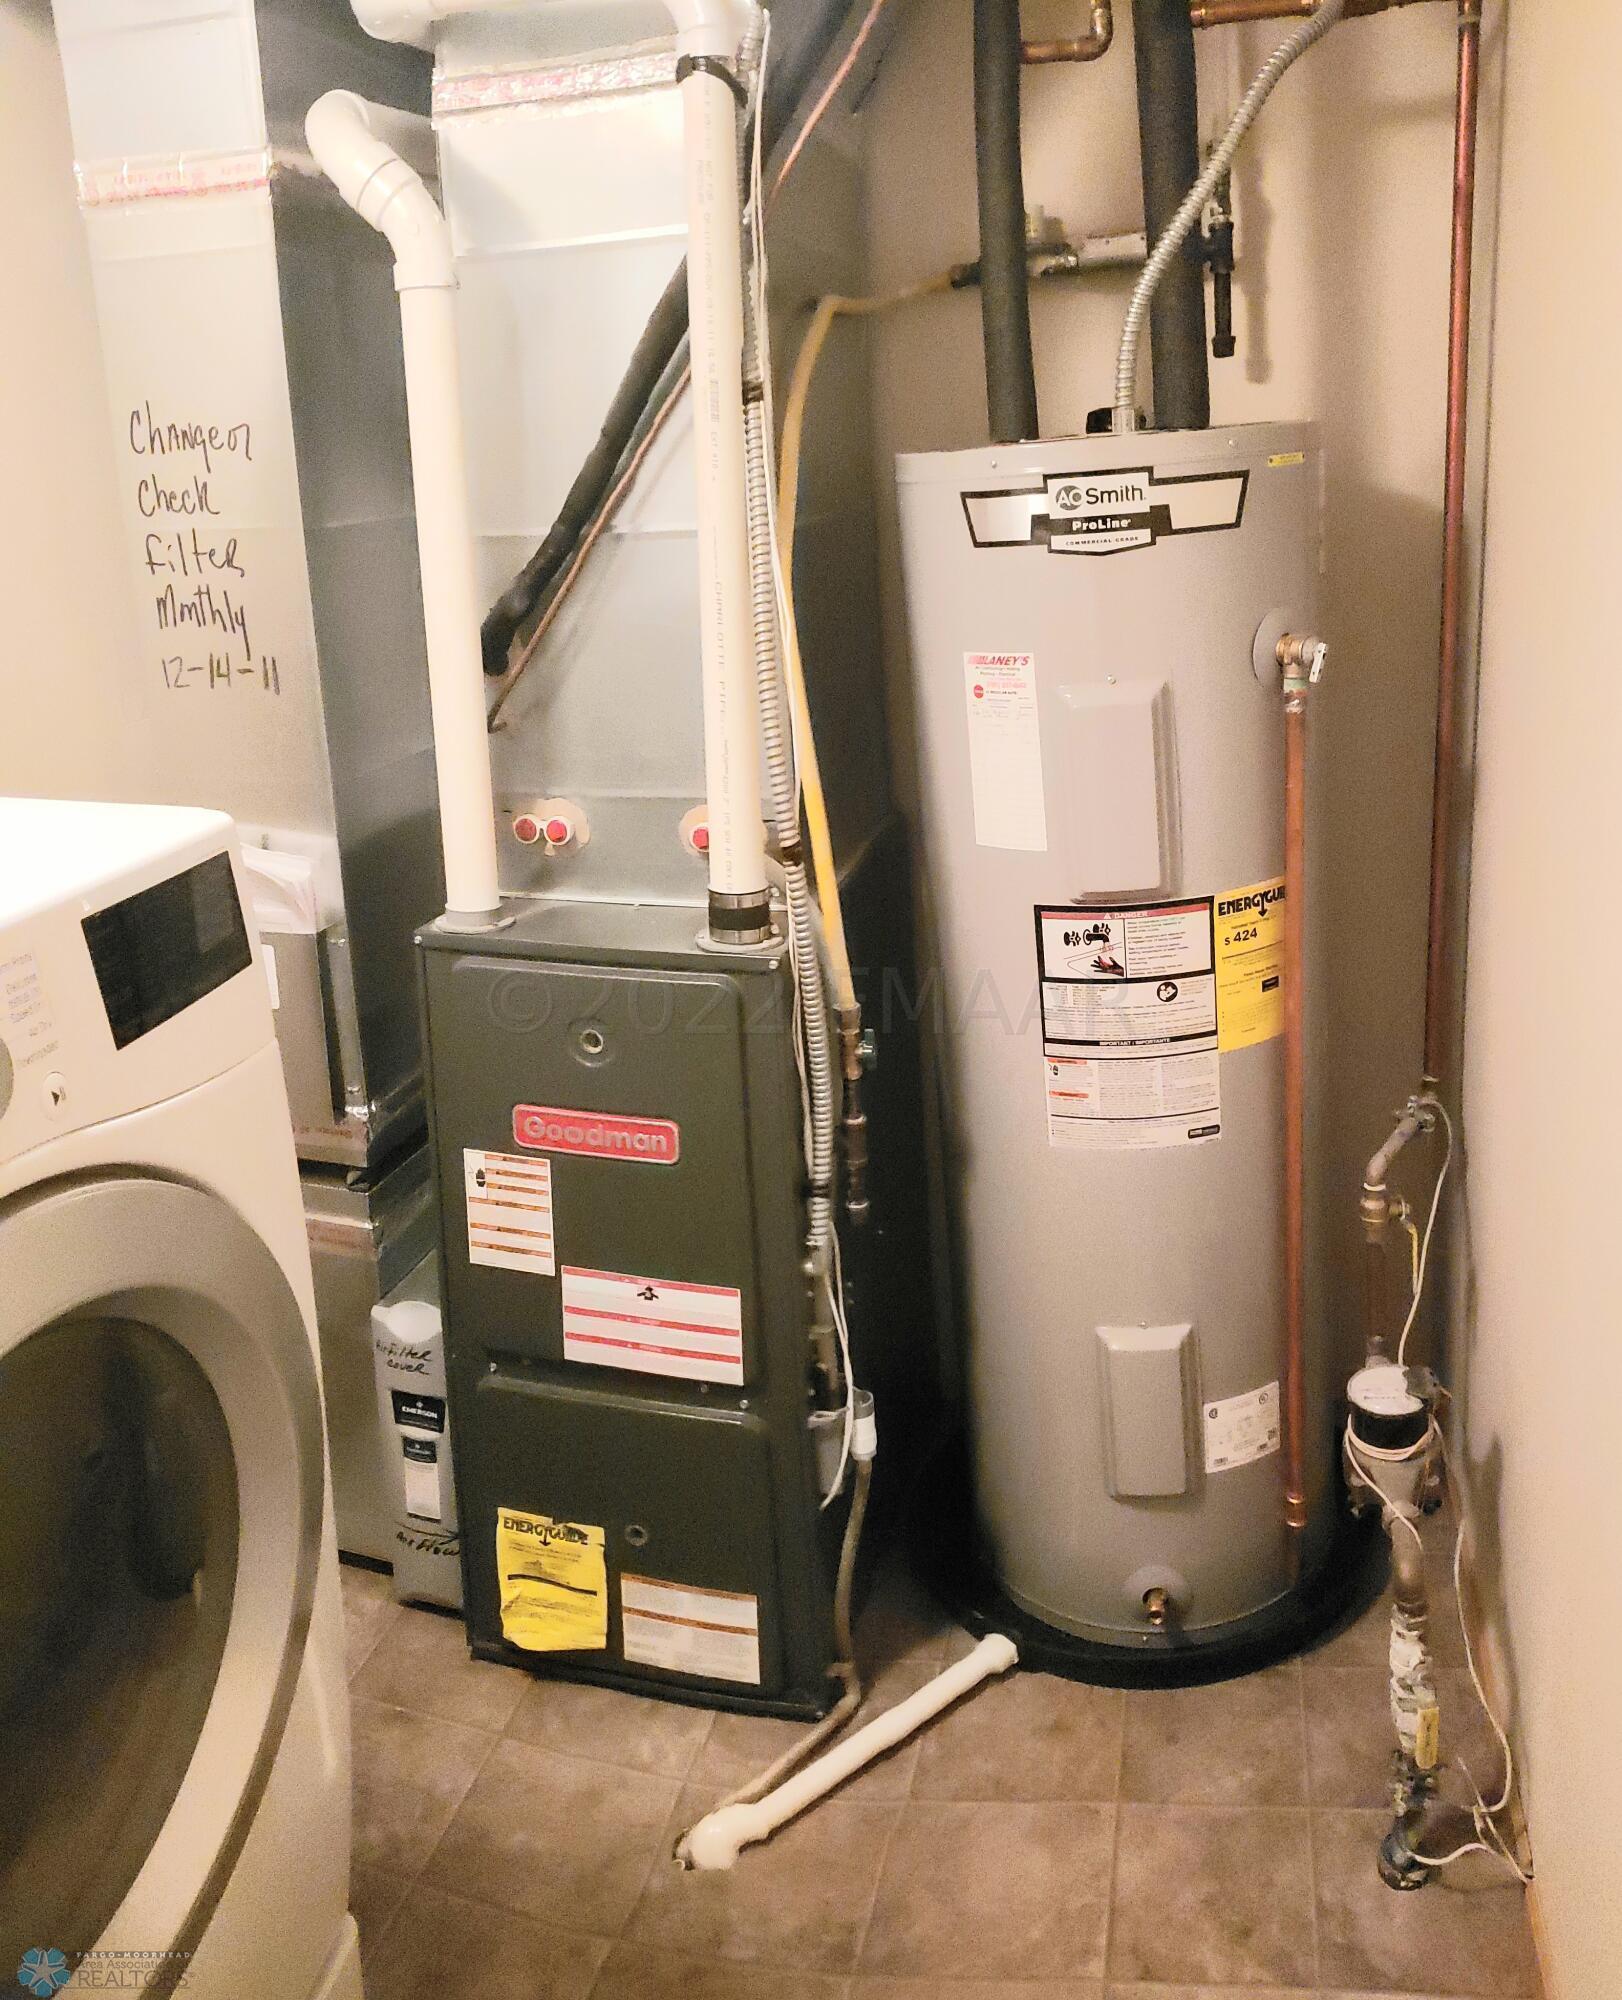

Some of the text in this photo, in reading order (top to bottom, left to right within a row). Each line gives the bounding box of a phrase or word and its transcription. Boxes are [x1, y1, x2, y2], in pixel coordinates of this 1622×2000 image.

[1085, 484, 1147, 505] Smith
[1072, 517, 1132, 532] ProLine
[1065, 535, 1140, 546] COMMERCIAL GRADE
[1114, 911, 1150, 919] DANGER
[1233, 927, 1258, 942] 424
[523, 1115, 668, 1153] Goodman
